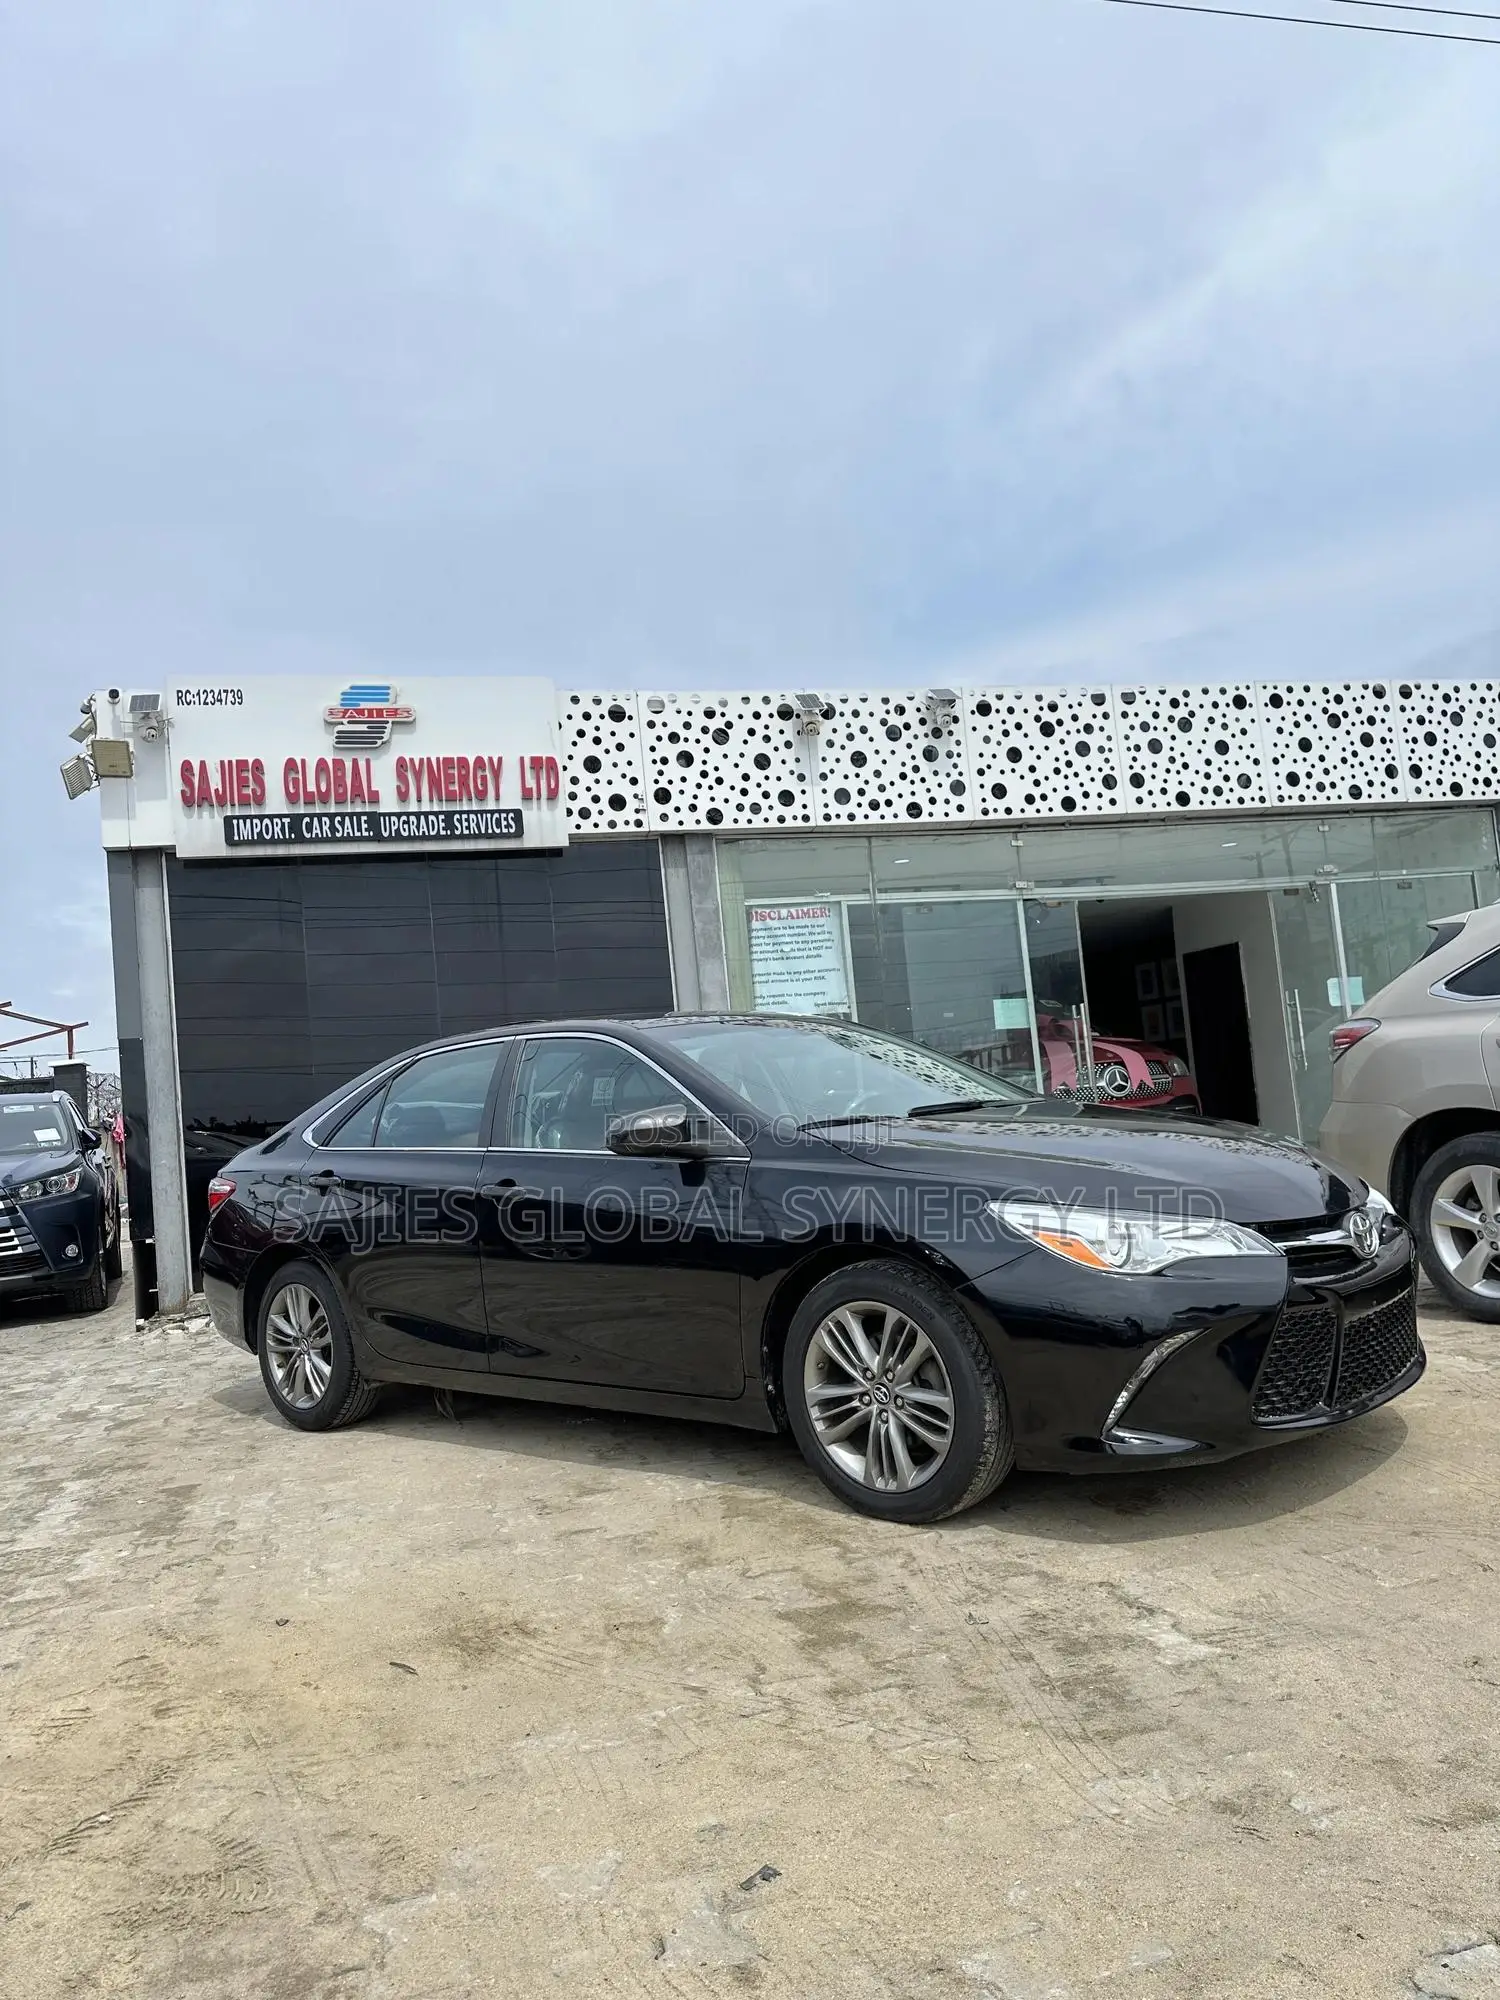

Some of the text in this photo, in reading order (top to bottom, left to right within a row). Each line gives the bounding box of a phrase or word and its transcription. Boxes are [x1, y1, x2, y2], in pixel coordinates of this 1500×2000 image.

[176, 688, 243, 706] RC:1234739
[327, 708, 413, 719] SAJIES
[180, 755, 560, 807] SAJIES GLOBAL SYNERGY LTD
[233, 818, 296, 842] IMPORT.
[302, 817, 330, 840] CAR
[381, 815, 451, 838] UPGRADE.
[454, 812, 516, 836] SERVICES
